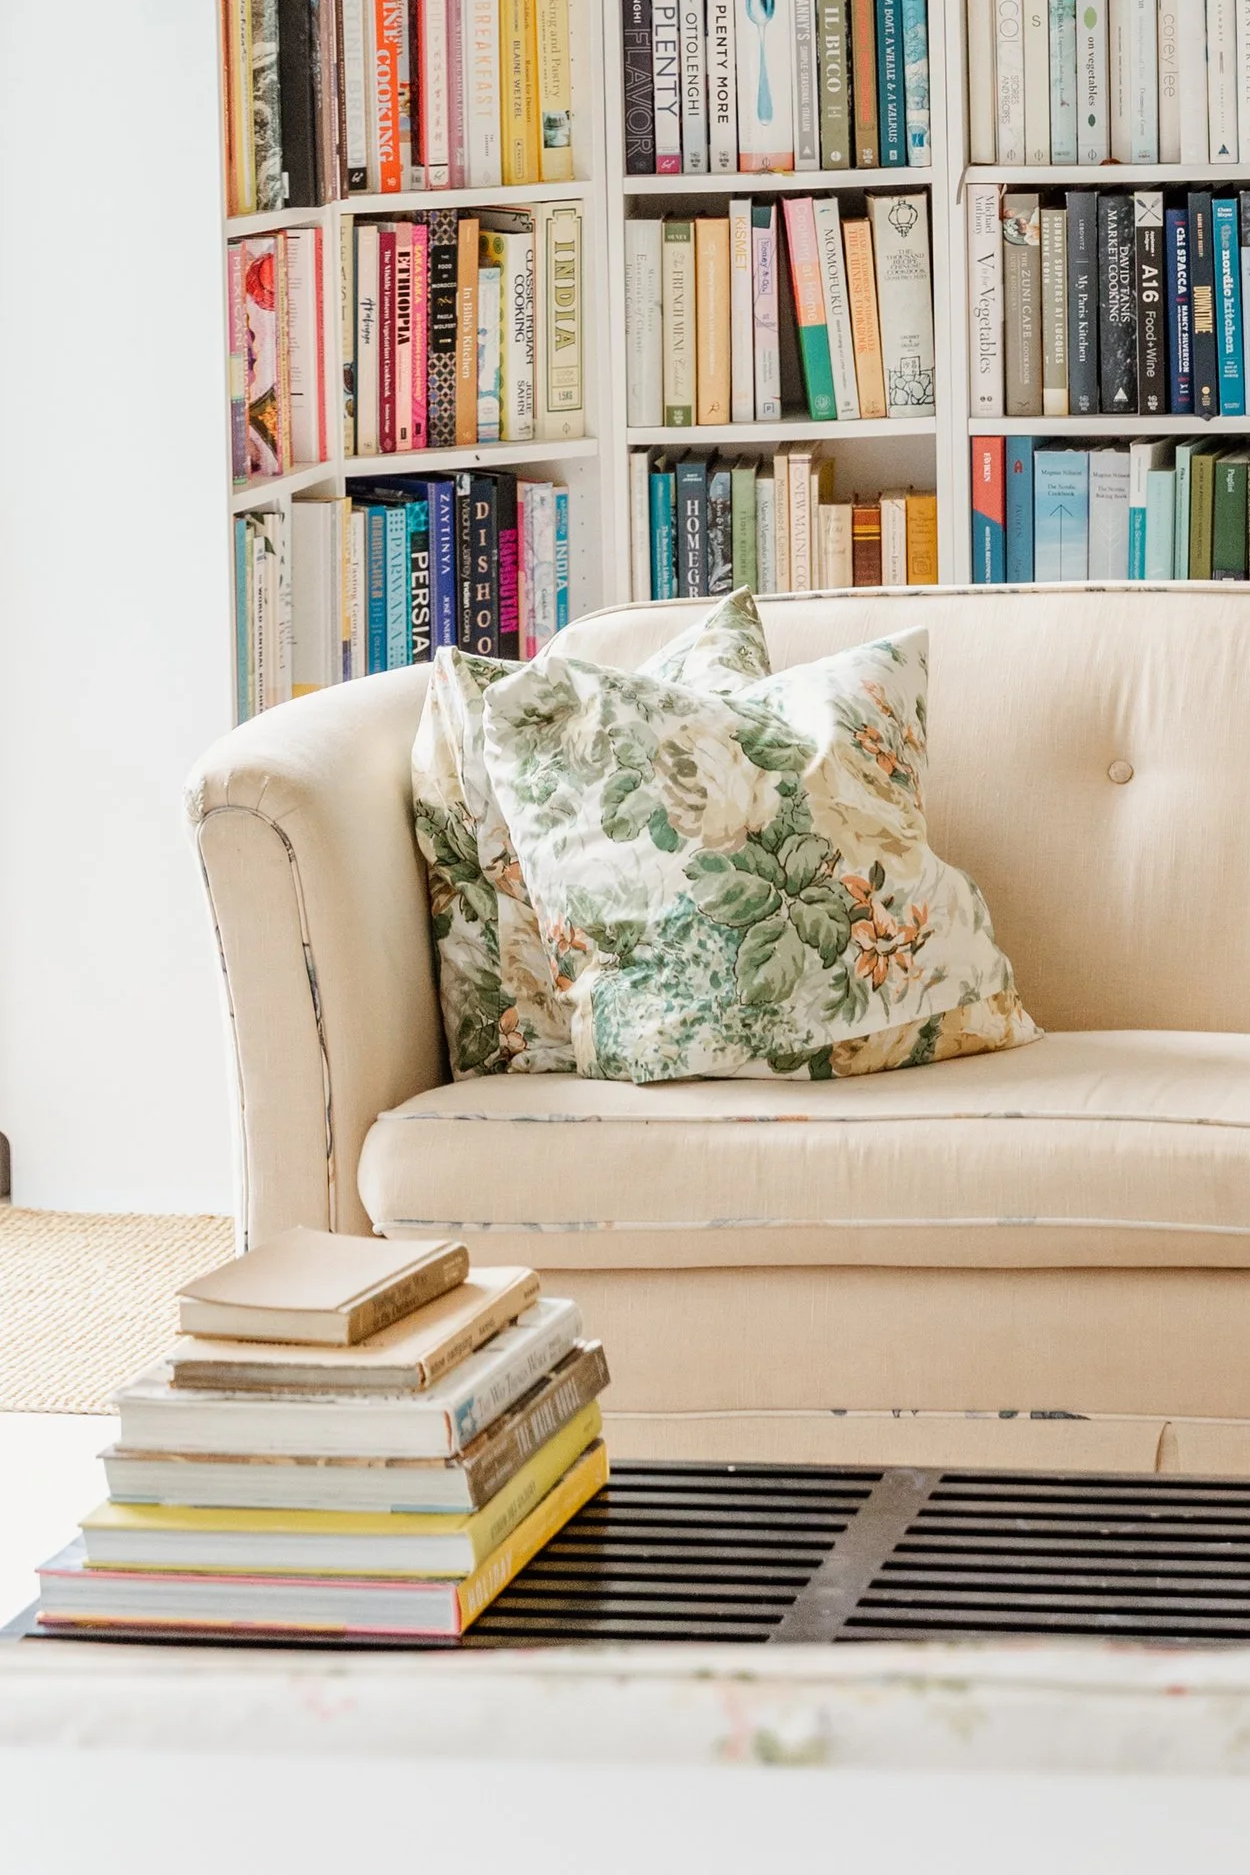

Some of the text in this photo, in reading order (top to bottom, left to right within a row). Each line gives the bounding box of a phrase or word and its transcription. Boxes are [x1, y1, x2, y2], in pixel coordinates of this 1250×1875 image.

[513, 40, 522, 119] BLAINE WETZEL
[550, 30, 561, 55] and
[550, 57, 563, 98] Pastry
[654, 6, 677, 117] PLENTY
[687, 12, 700, 117] OTTOLENGHI
[716, 4, 729, 124] PLENTY MORE
[825, 6, 842, 93] IL BUCO
[1086, 36, 1099, 106] on vegetables
[1160, 13, 1178, 98] corey lee
[625, 29, 652, 157] FLAVOR
[397, 251, 411, 345] ETHIOPIA
[515, 274, 526, 343] COOKING
[554, 240, 576, 352] INDIA
[823, 228, 843, 316] MOMOFUKU
[1107, 209, 1120, 322] MARKET COOKING
[1119, 246, 1132, 323] DAVID TANIS
[1141, 264, 1160, 303] A16
[974, 253, 996, 374] V Vegetables
[1075, 274, 1089, 362] My Paris Kitchen
[1144, 310, 1158, 378] Food+Wine
[391, 535, 405, 641] PARWANA
[410, 551, 428, 655] PERSIA
[556, 539, 569, 592] INDIA
